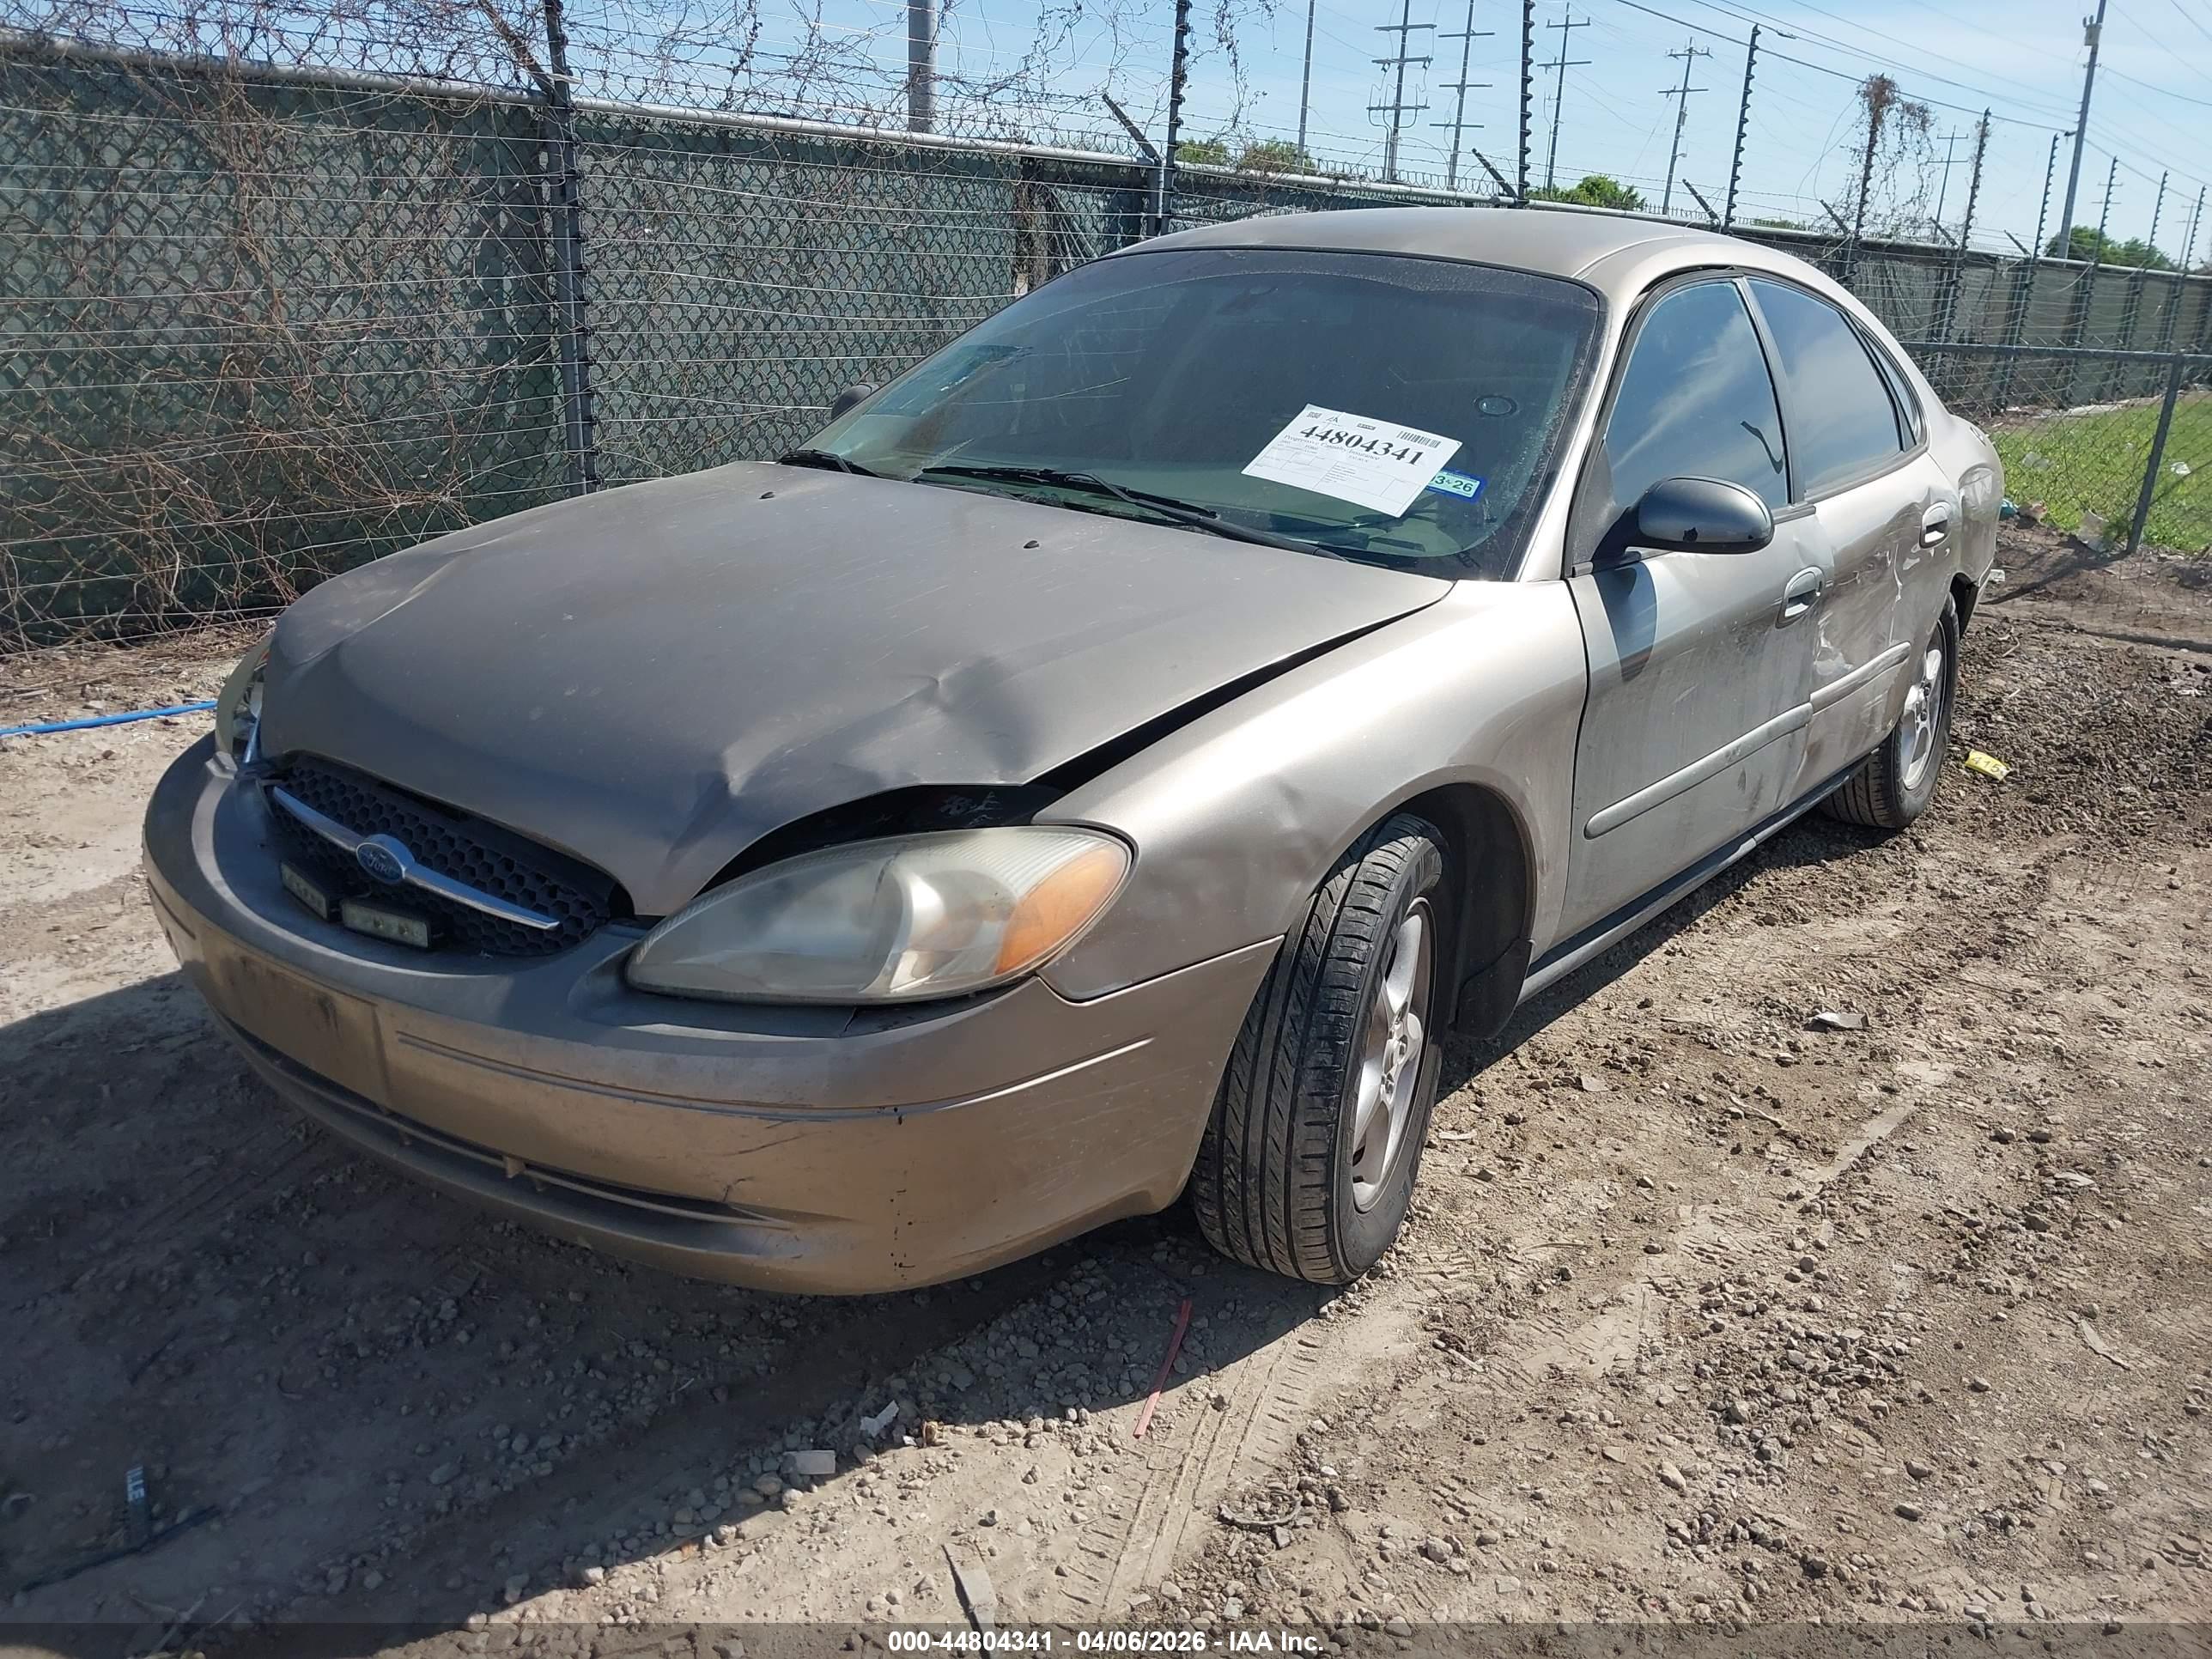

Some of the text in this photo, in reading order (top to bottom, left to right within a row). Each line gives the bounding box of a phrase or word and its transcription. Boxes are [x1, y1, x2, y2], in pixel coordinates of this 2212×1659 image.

[1300, 426, 1424, 466] 44804341
[1452, 480, 1474, 492] 26
[362, 847, 398, 876] Ford
